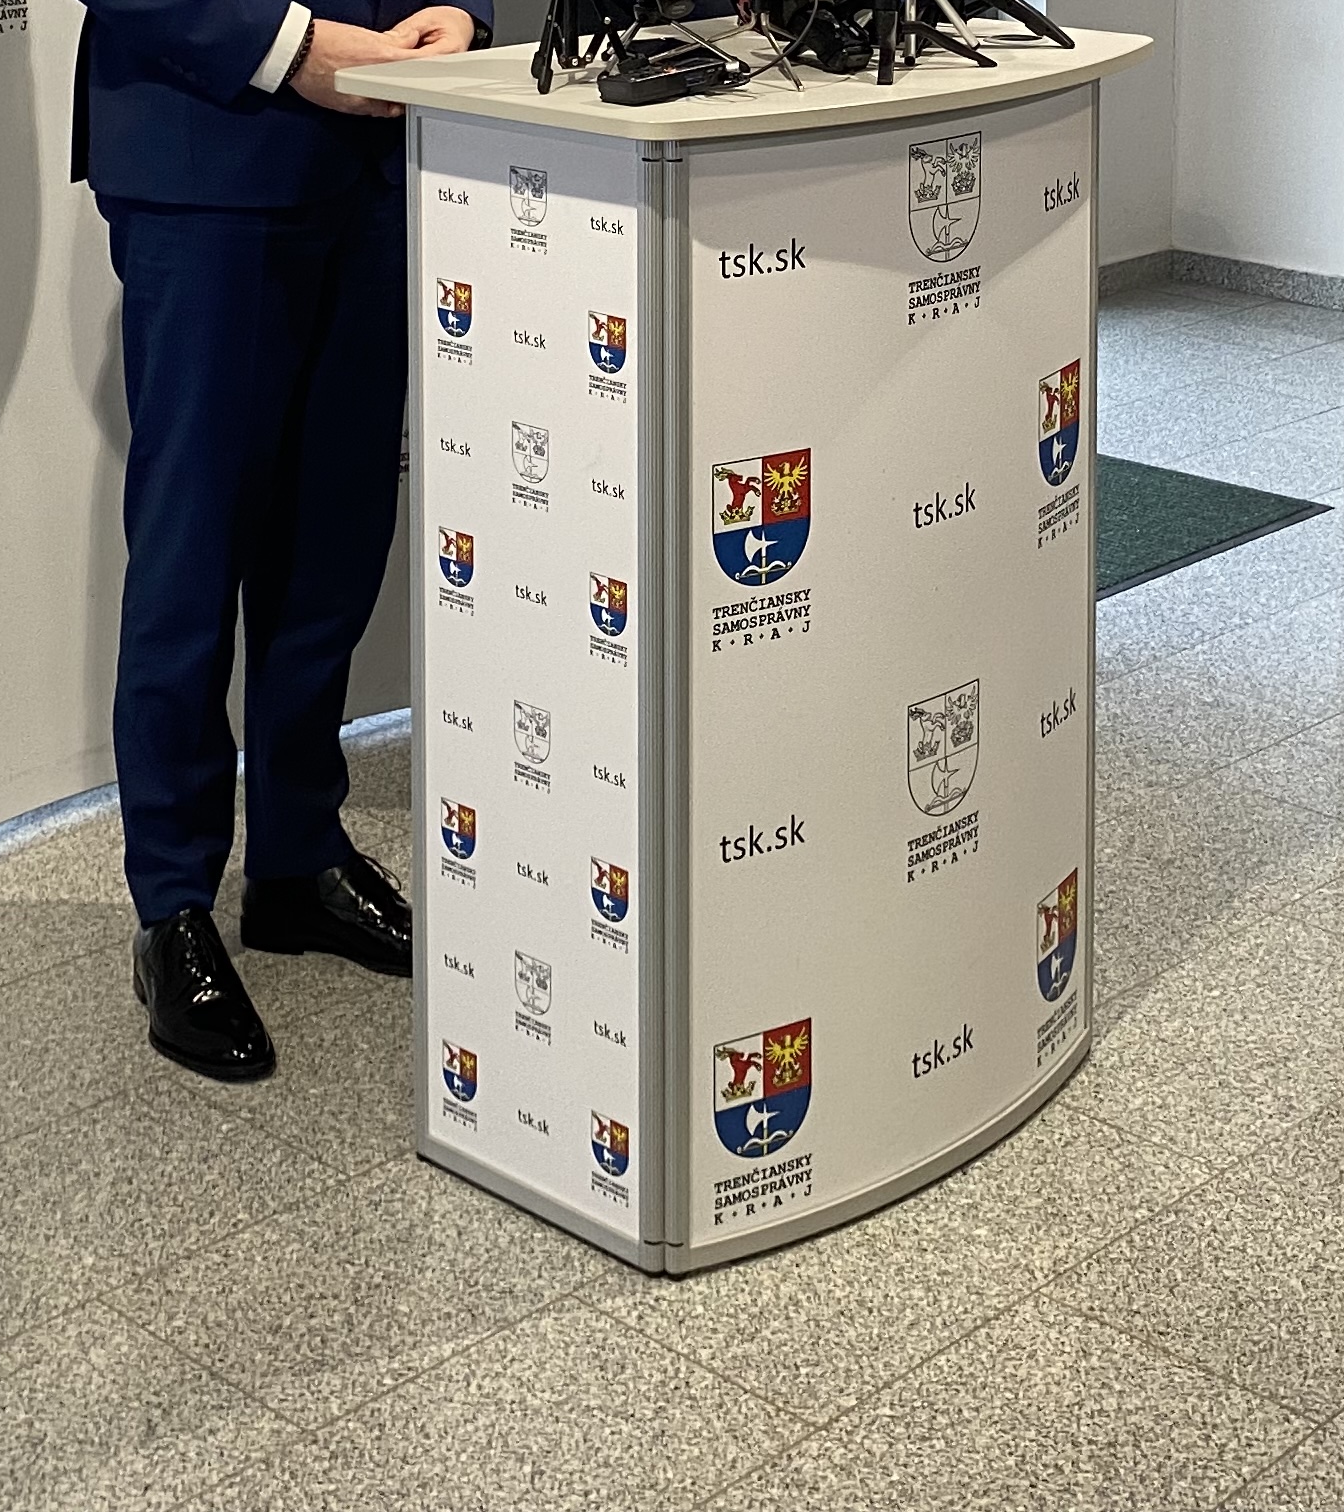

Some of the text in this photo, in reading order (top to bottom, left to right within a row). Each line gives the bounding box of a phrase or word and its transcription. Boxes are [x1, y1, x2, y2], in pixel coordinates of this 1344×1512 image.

[438, 187, 469, 206] tsk.sk
[1044, 171, 1079, 212] tsk.sk
[590, 216, 624, 236] tsk.sk
[718, 238, 806, 279] tsk.sk
[908, 266, 981, 294] TRENČIANSKY
[908, 281, 981, 309] SAMOSPRÁVNY
[514, 330, 546, 349] tsk.sk
[440, 437, 471, 457] tsk.sk
[592, 478, 625, 500] tsk.sk
[913, 482, 975, 528] tsk.sk
[515, 584, 547, 607] tsk.sk
[712, 588, 811, 619] TRENČIANSKY
[712, 604, 811, 636] SAMOSPRÁVNY
[443, 709, 473, 732] tsk.sk
[1040, 686, 1076, 738] tsk.sk
[593, 764, 626, 789] tsk.sk
[719, 814, 805, 863] tsk.sk
[907, 825, 979, 867] SAMOSPRÁVNY
[908, 810, 979, 852] TRENČIANSKY
[517, 861, 549, 886] tsk.sk
[912, 1023, 973, 1078] tsk.sk
[714, 1153, 812, 1194] TRENČIANSKY
[714, 1169, 812, 1209] SAMOSPRÁVNY
